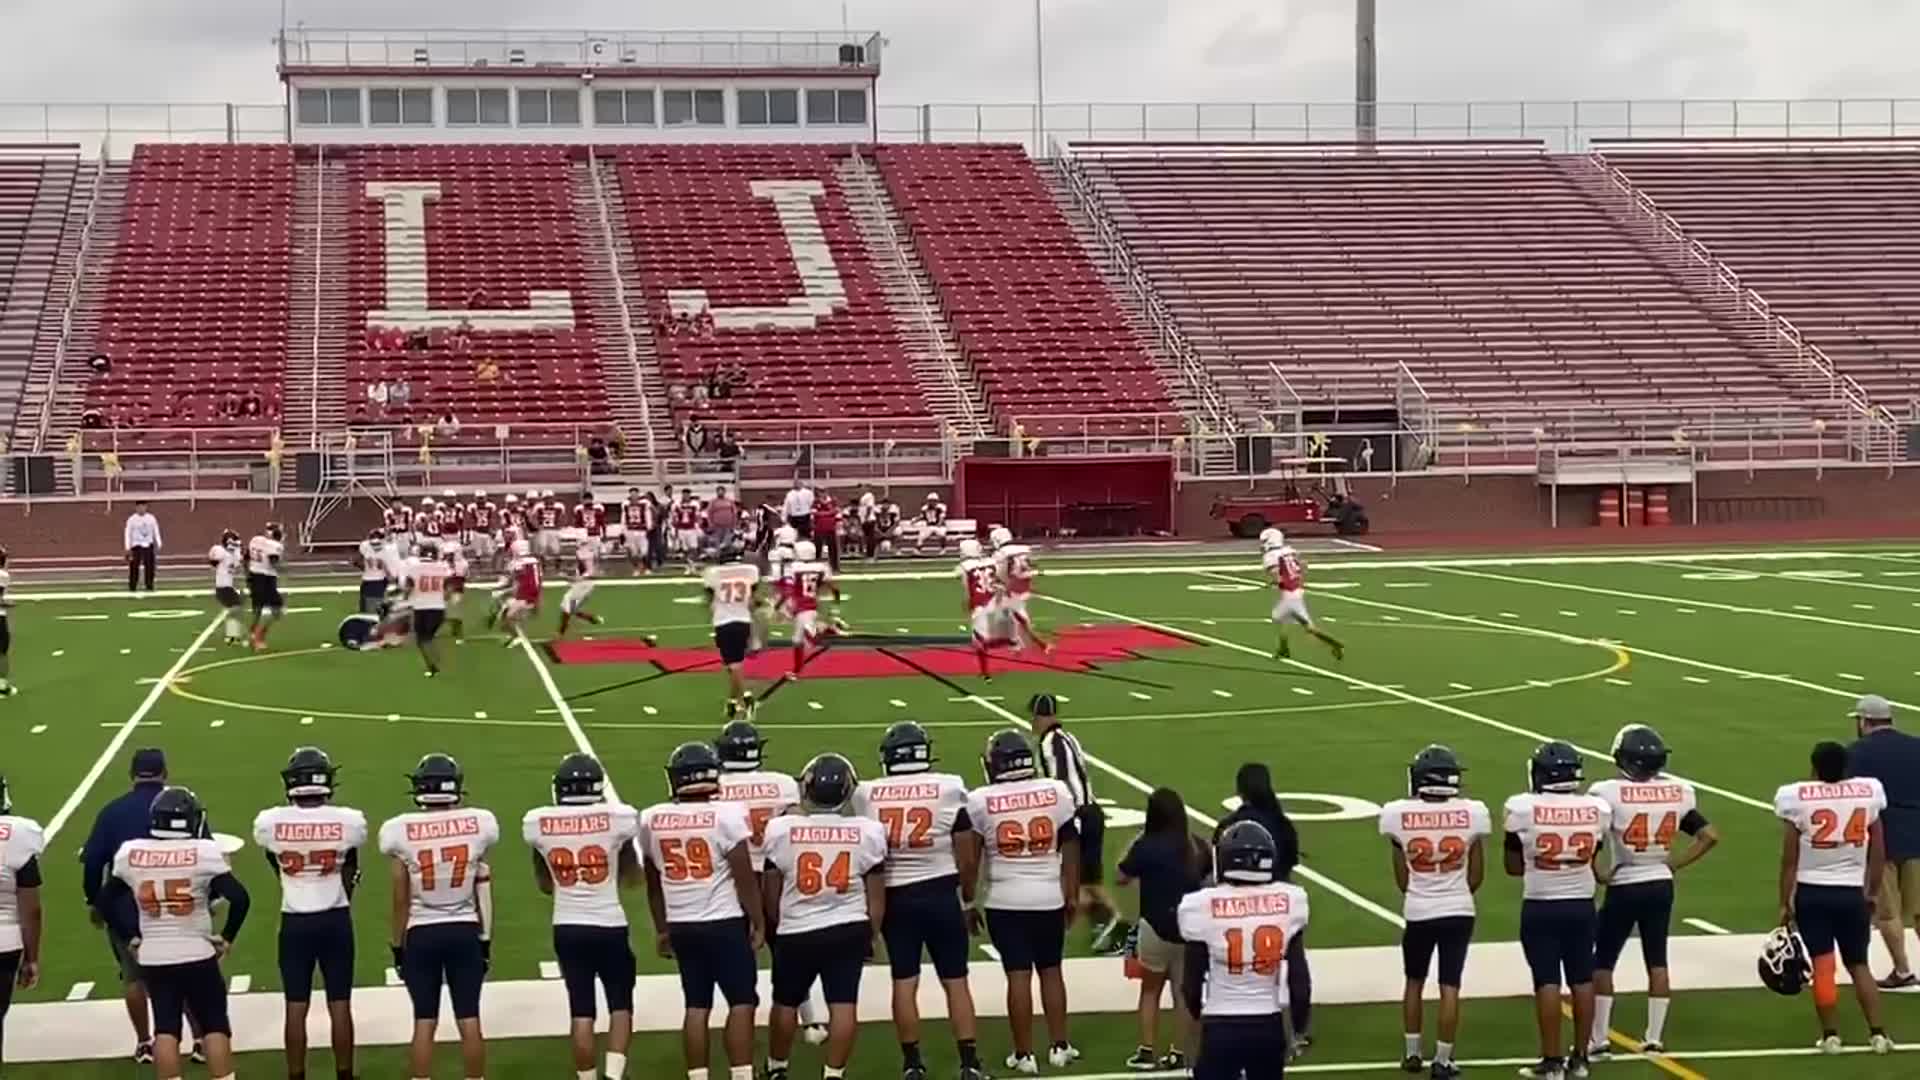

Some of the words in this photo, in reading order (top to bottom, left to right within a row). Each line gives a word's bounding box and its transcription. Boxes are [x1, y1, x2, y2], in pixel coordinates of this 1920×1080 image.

[365, 181, 575, 331] L
[668, 179, 848, 329] J
[872, 784, 939, 800] JAGUARS
[986, 790, 1056, 814] JAGUARS
[1621, 785, 1682, 803] JAGUARS
[1799, 783, 1873, 800] JAGUARS
[539, 813, 610, 836] JAGUARS
[652, 812, 716, 831] JAGUARS
[879, 807, 933, 848] 72
[1402, 811, 1470, 830] JAGUARS
[1534, 806, 1598, 825] JAGUARS
[275, 823, 343, 841] JAGUARS
[405, 817, 480, 841] JAGUARS
[791, 827, 861, 843] JAGUARS
[1623, 811, 1676, 853] 44
[1811, 808, 1867, 849] 24
[129, 850, 197, 868] JAGUARS
[659, 837, 714, 881] 59
[1407, 836, 1465, 873] 22
[416, 844, 469, 891] 17
[797, 851, 850, 895] 64
[139, 878, 195, 917] 45
[1211, 892, 1289, 918] JAGUARS
